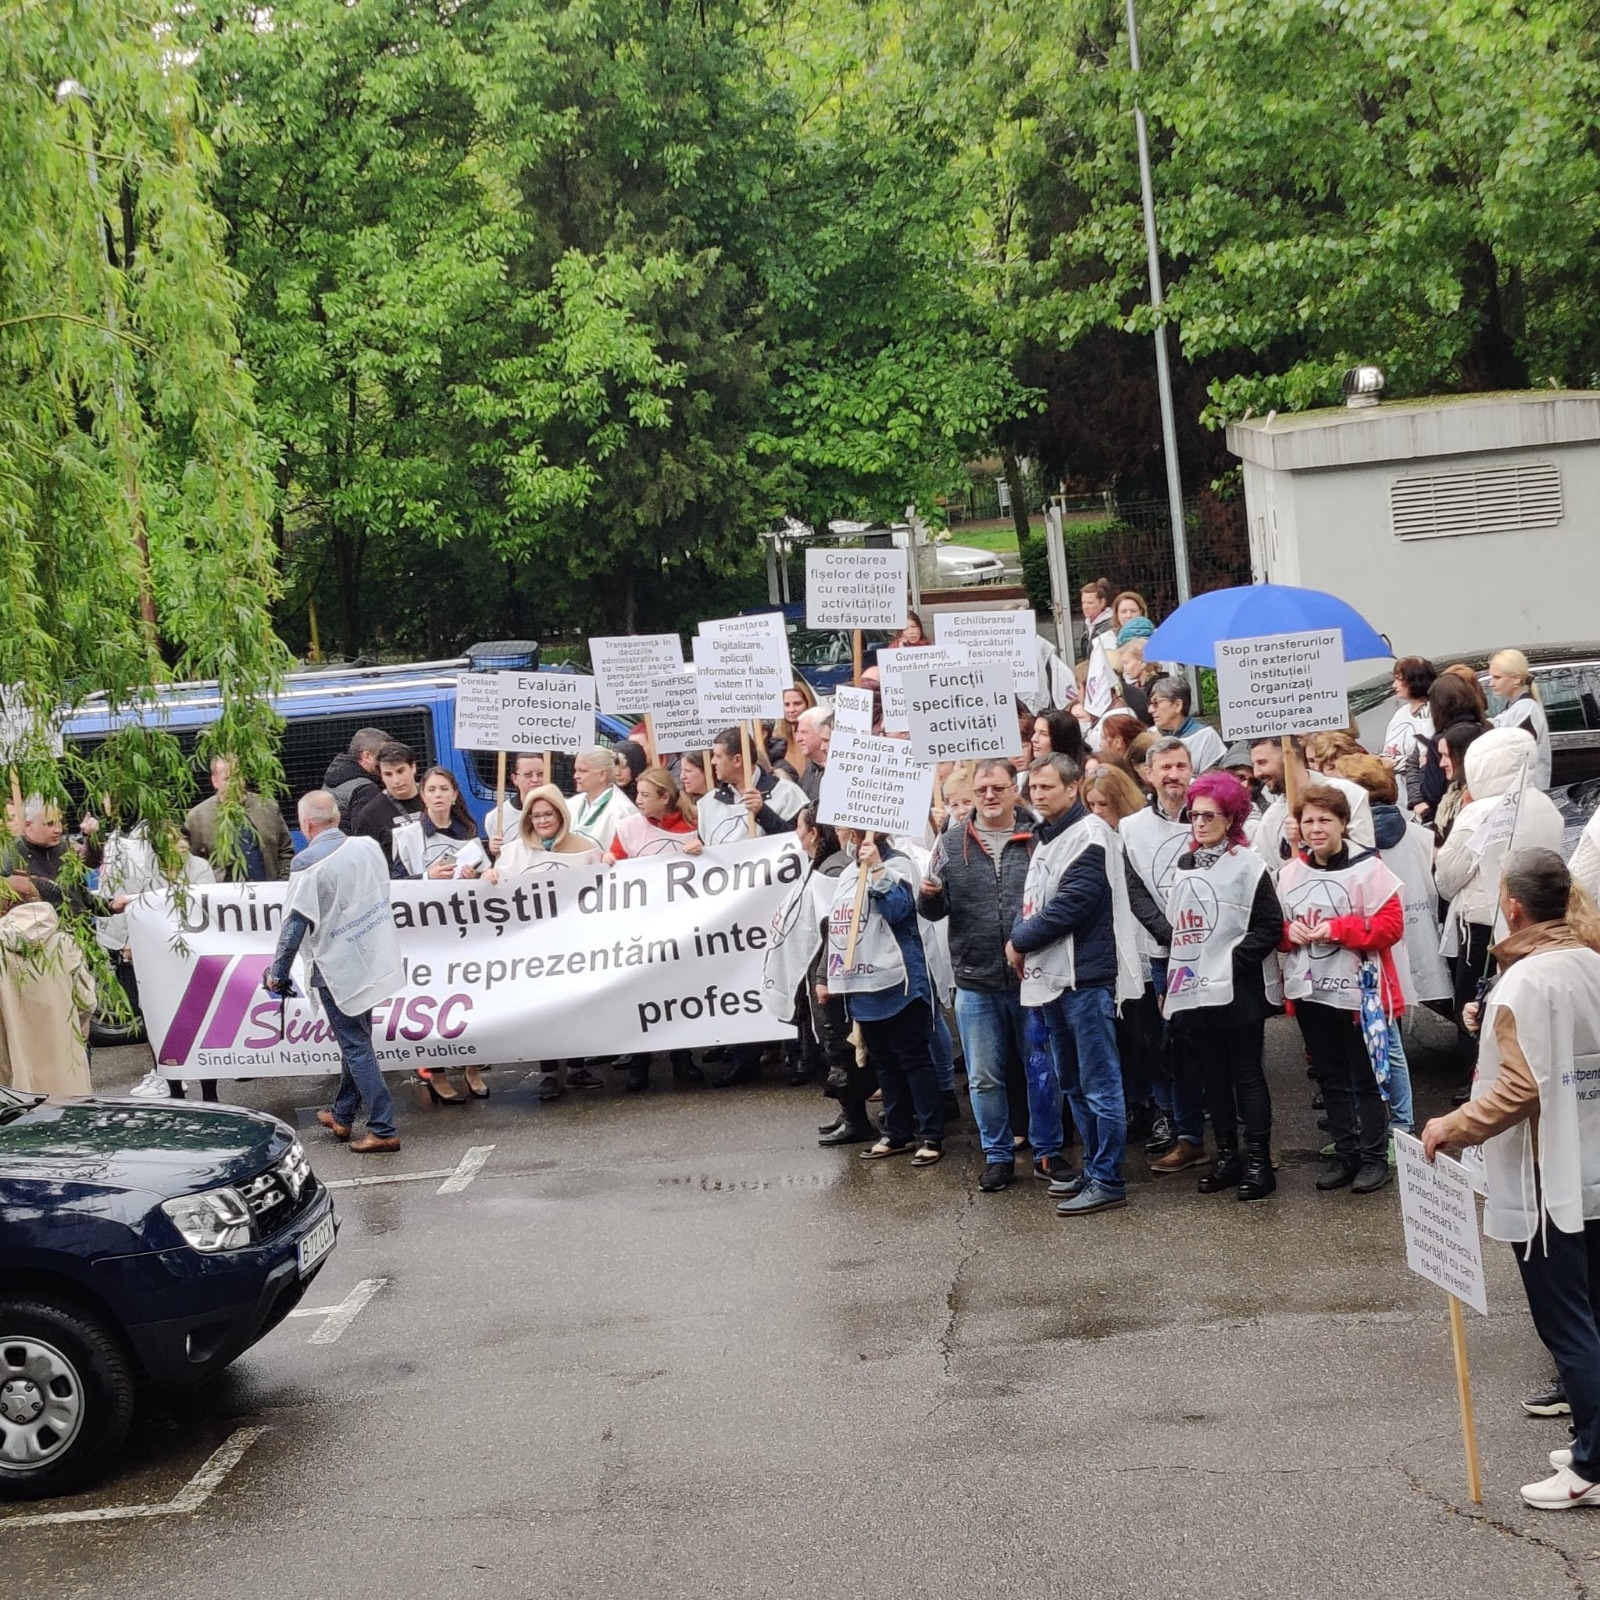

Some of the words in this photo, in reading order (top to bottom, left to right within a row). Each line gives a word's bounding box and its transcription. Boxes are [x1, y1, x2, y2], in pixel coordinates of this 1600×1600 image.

[826, 554, 887, 565] Corelarea
[811, 569, 851, 581] fișelor
[855, 570, 870, 579] de
[874, 570, 902, 581] post
[818, 586, 833, 594] cu
[837, 584, 896, 596] realitățile
[821, 599, 893, 611] activităților
[817, 613, 896, 626] desfășurate!
[953, 615, 1015, 626] Echilibrarea/
[944, 627, 1026, 638] redimensionarea
[712, 640, 764, 652] Digitalizare,
[1222, 645, 1250, 656] Stop
[1254, 636, 1335, 652] transferurilor
[1239, 657, 1258, 668] din
[1262, 650, 1320, 665] exteriorul
[697, 667, 746, 676] informatice
[517, 677, 577, 693] Evaluări
[651, 676, 694, 687] SindFISC
[714, 680, 742, 688] sistem
[757, 680, 764, 688] la
[929, 671, 984, 688] Funcții
[1250, 677, 1313, 694] Organizați
[704, 692, 732, 701] nivelul
[912, 694, 989, 714] specifice,
[994, 692, 1008, 706] la
[1228, 692, 1294, 709] concursuri
[1298, 690, 1338, 703] pentru
[501, 697, 592, 711] profesionale
[653, 700, 681, 709] relația
[666, 709, 690, 718] celor
[1256, 706, 1313, 719] ocuparea
[518, 716, 577, 728] corecte/
[929, 714, 997, 732] activități
[1228, 721, 1288, 737] posturilor
[1292, 715, 1343, 729] vacante!
[511, 733, 582, 747] obiective!
[658, 728, 705, 740] propuneri,
[852, 738, 895, 753] Politica
[928, 737, 1005, 757] specifice!
[831, 750, 881, 764] personal
[839, 762, 864, 774] spre
[871, 764, 921, 781] faliment!
[851, 776, 904, 793] Solicităm
[846, 787, 904, 805] întinerirea
[847, 801, 900, 817] structurii
[833, 812, 910, 830] personalului!
[578, 873, 647, 914] din
[447, 934, 679, 990] reprezentăm
[694, 923, 768, 958] inte
[638, 984, 763, 1032] profes
[198, 1052, 275, 1067] Sindicatul
[415, 1043, 477, 1060] Publice
[1396, 1136, 1407, 1153] Nu
[1408, 1146, 1417, 1159] ne
[1449, 1257, 1459, 1271] cu
